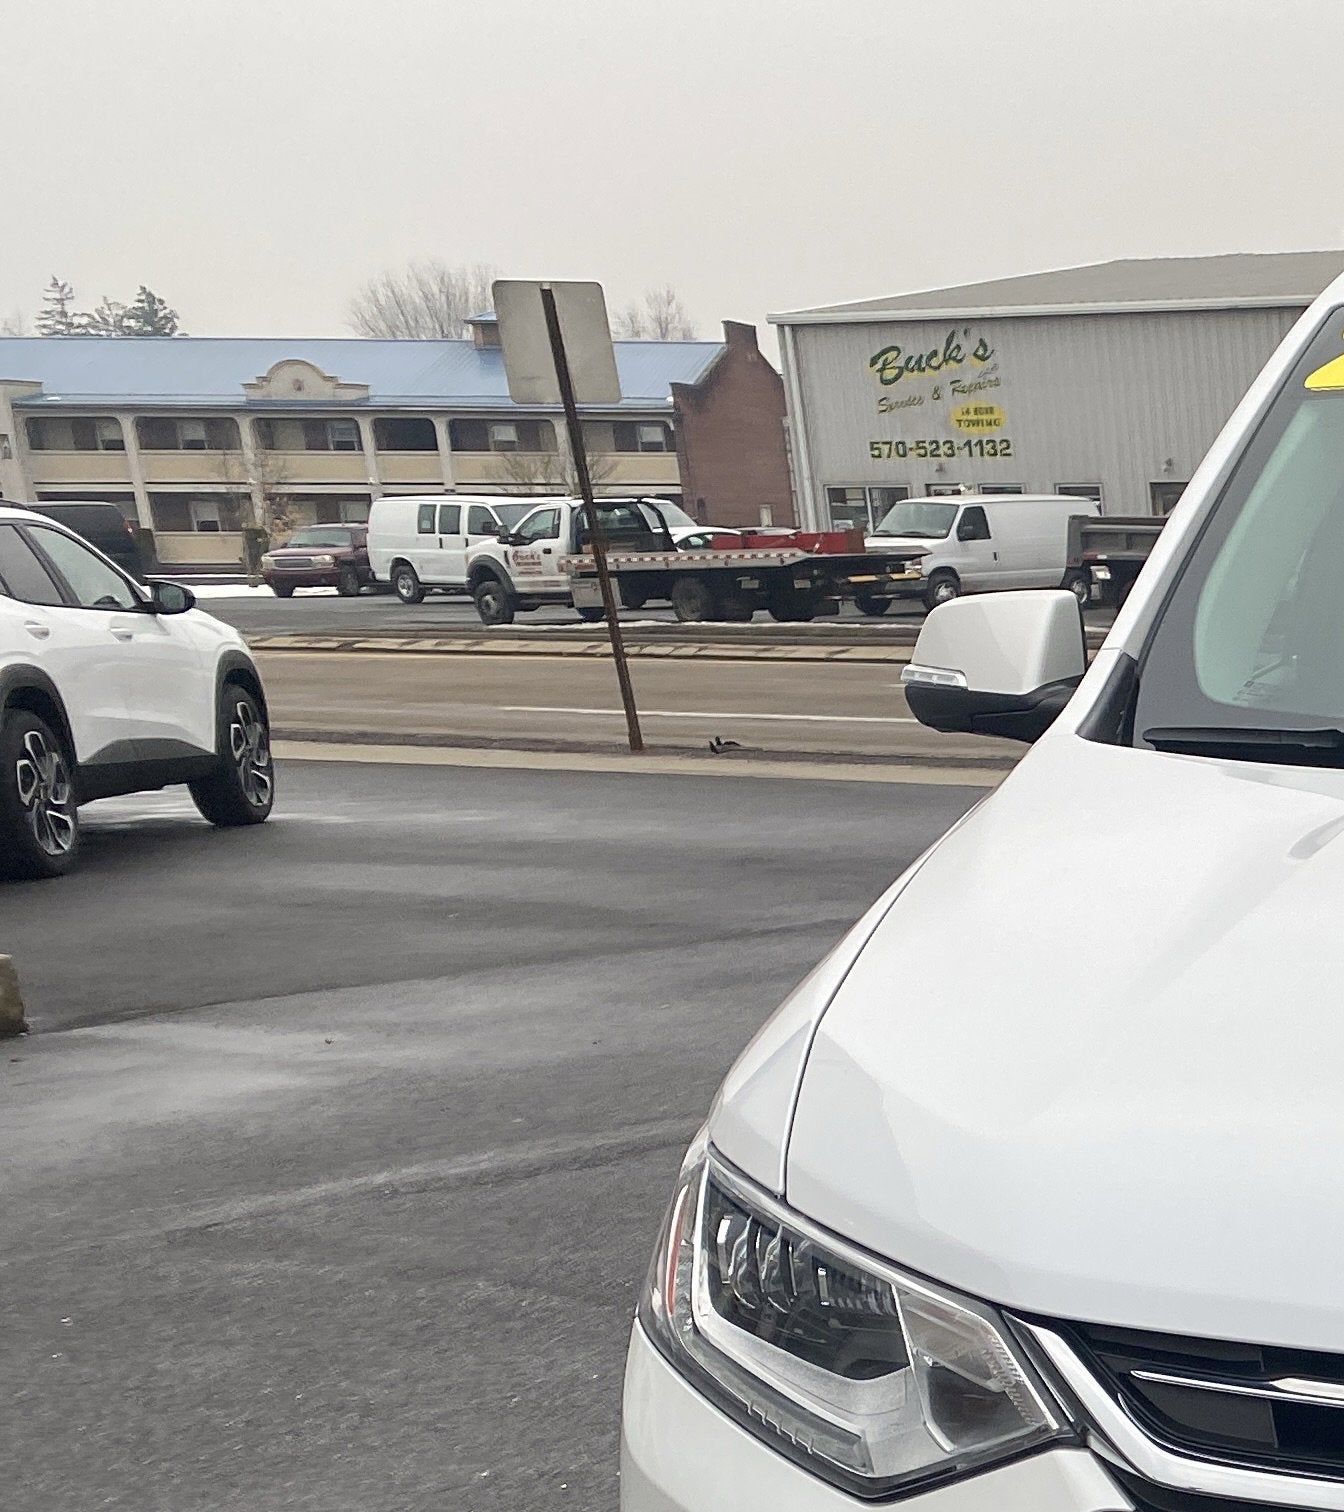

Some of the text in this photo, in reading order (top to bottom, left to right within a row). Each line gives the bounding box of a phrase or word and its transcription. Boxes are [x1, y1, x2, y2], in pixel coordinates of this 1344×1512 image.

[869, 328, 995, 386] Buck's
[931, 384, 941, 401] &
[955, 418, 1001, 428] TOWING
[869, 439, 1012, 459] 570-523-1132
